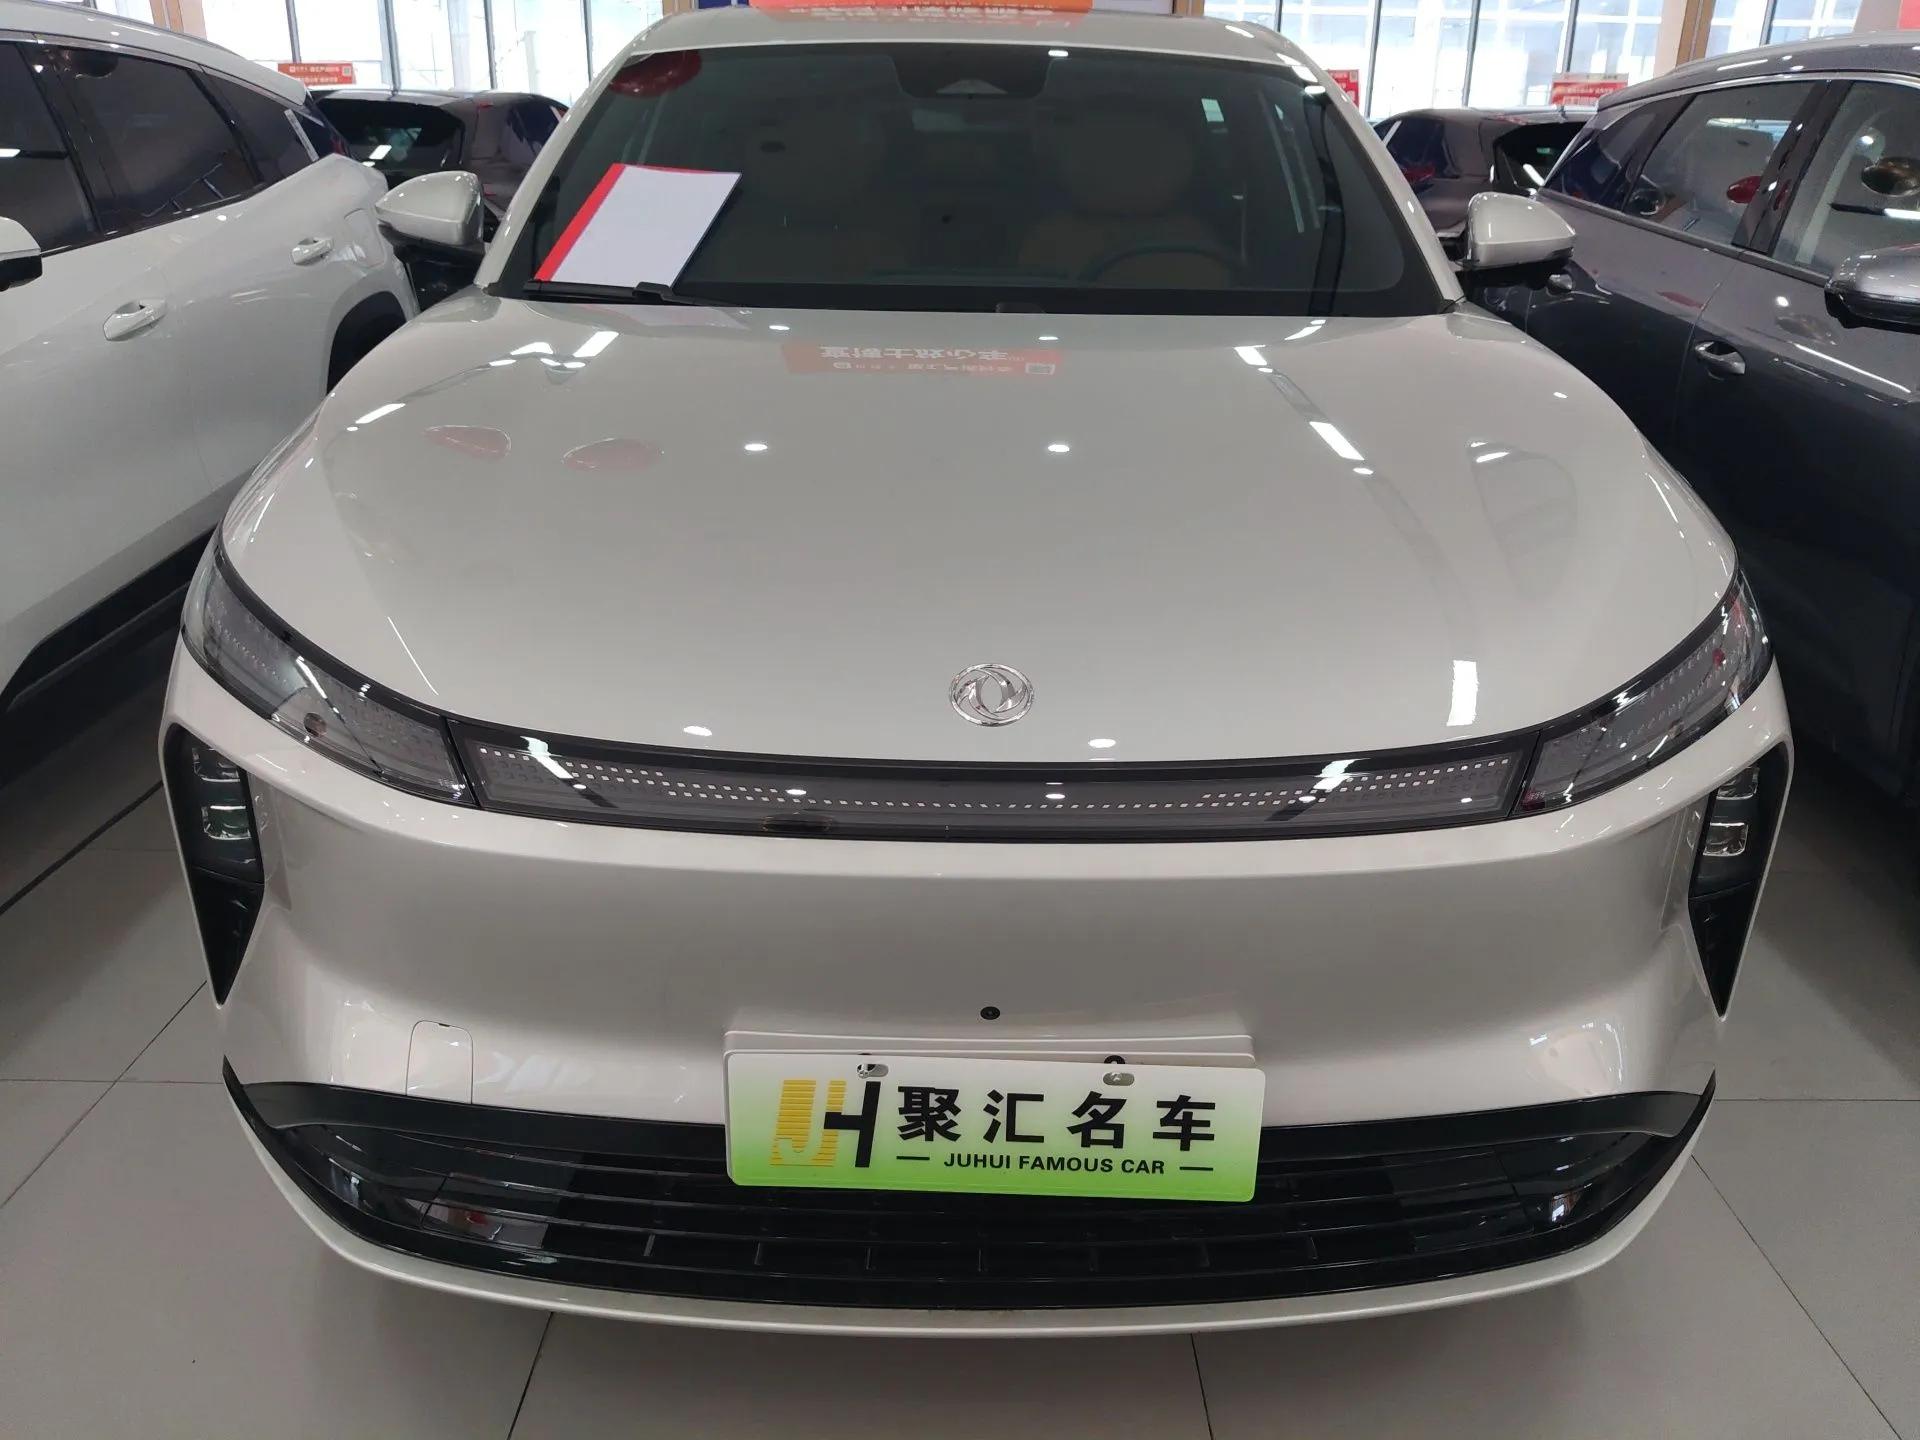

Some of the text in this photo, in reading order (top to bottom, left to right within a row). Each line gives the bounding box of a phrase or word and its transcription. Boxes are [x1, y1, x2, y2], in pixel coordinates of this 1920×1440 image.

[897, 1085, 1216, 1151] 聚汇名车
[943, 1152, 1165, 1175] JUHUI FAMOUS CAR
